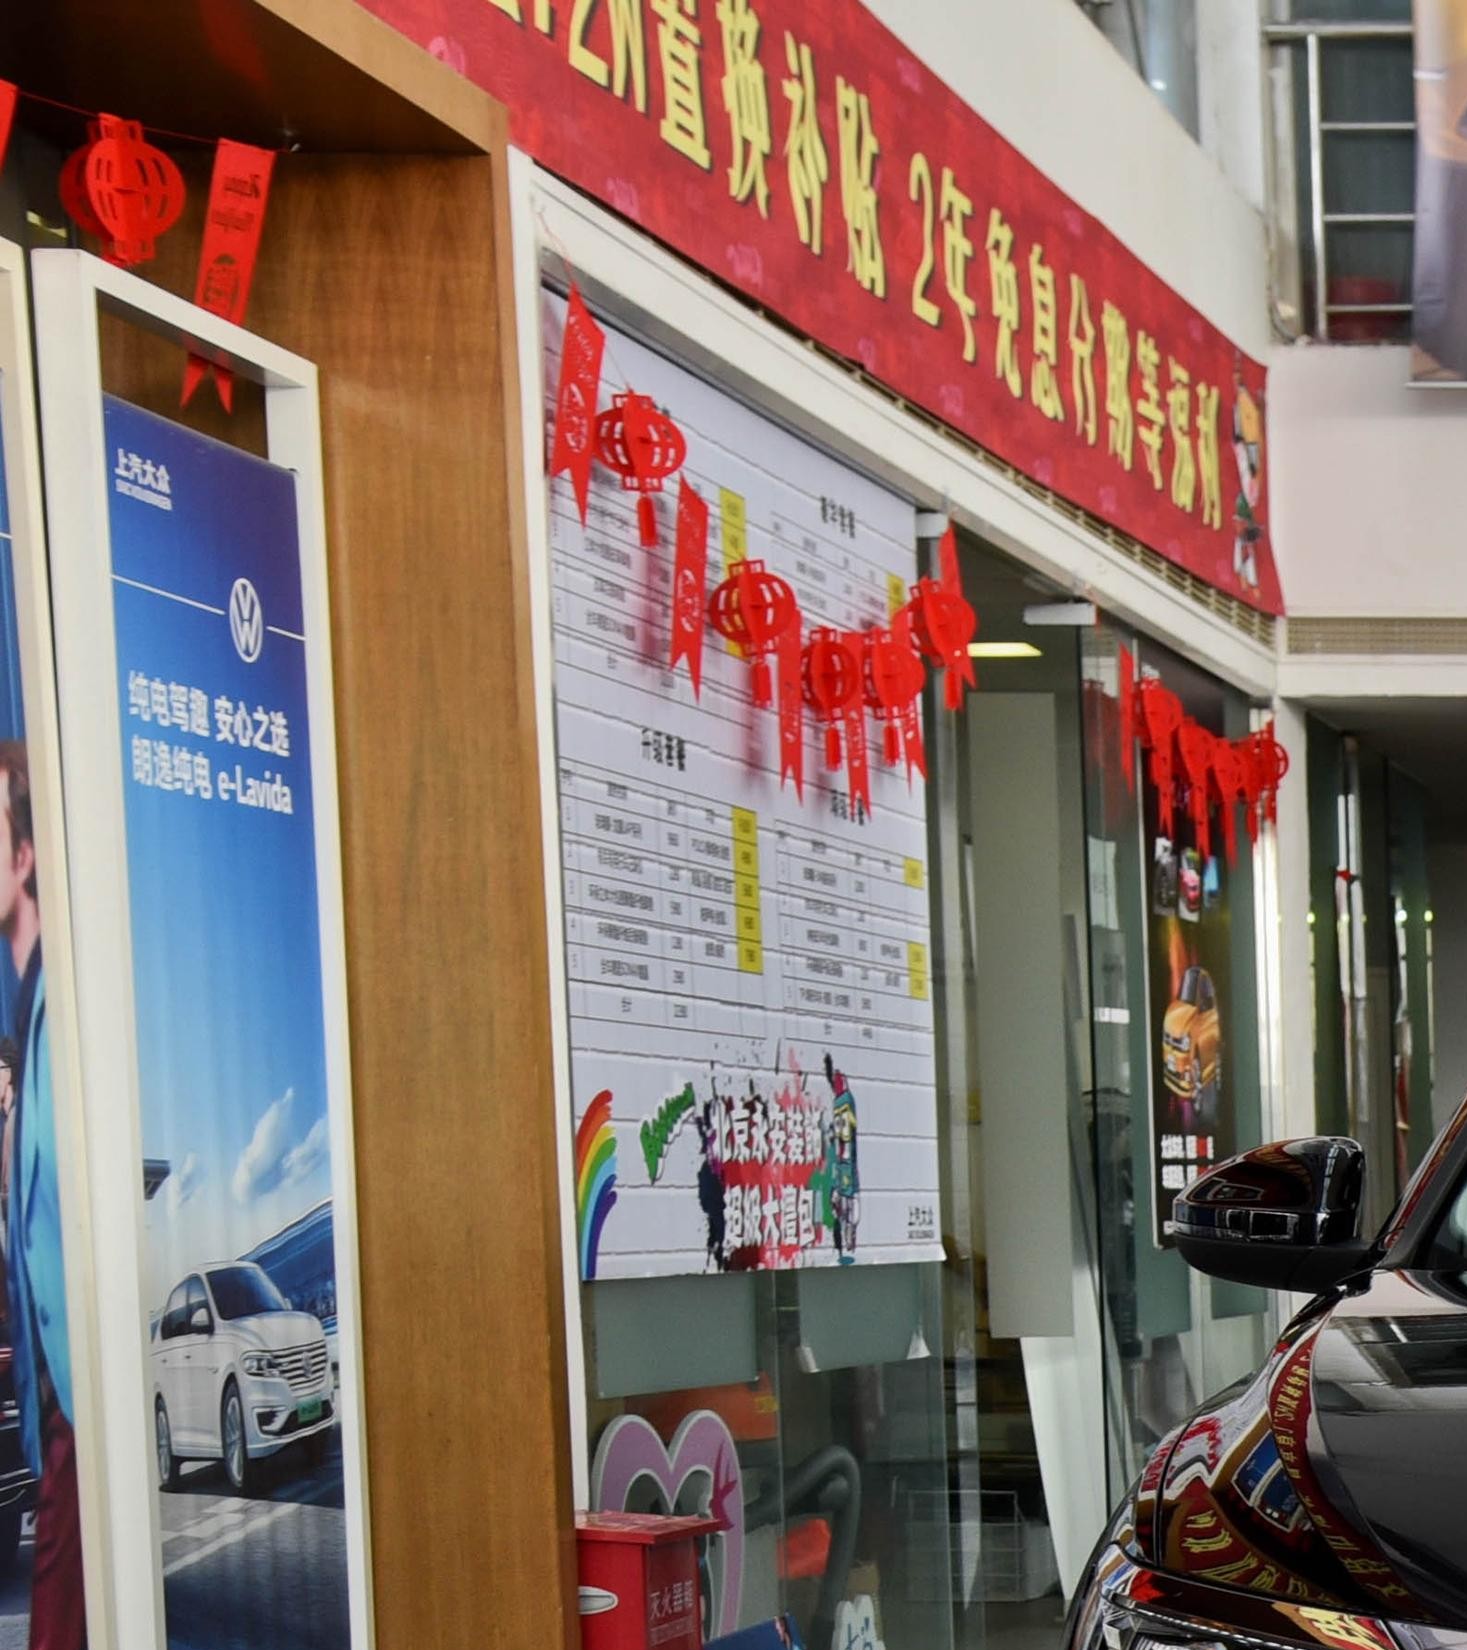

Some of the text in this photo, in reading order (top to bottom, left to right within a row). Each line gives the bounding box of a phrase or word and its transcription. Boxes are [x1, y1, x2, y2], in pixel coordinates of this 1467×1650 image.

[113, 448, 171, 495] 上汽大众
[128, 670, 291, 757] 纯电驾趣 安心之选
[131, 734, 293, 816] 朗逸纯电 e-Lavida
